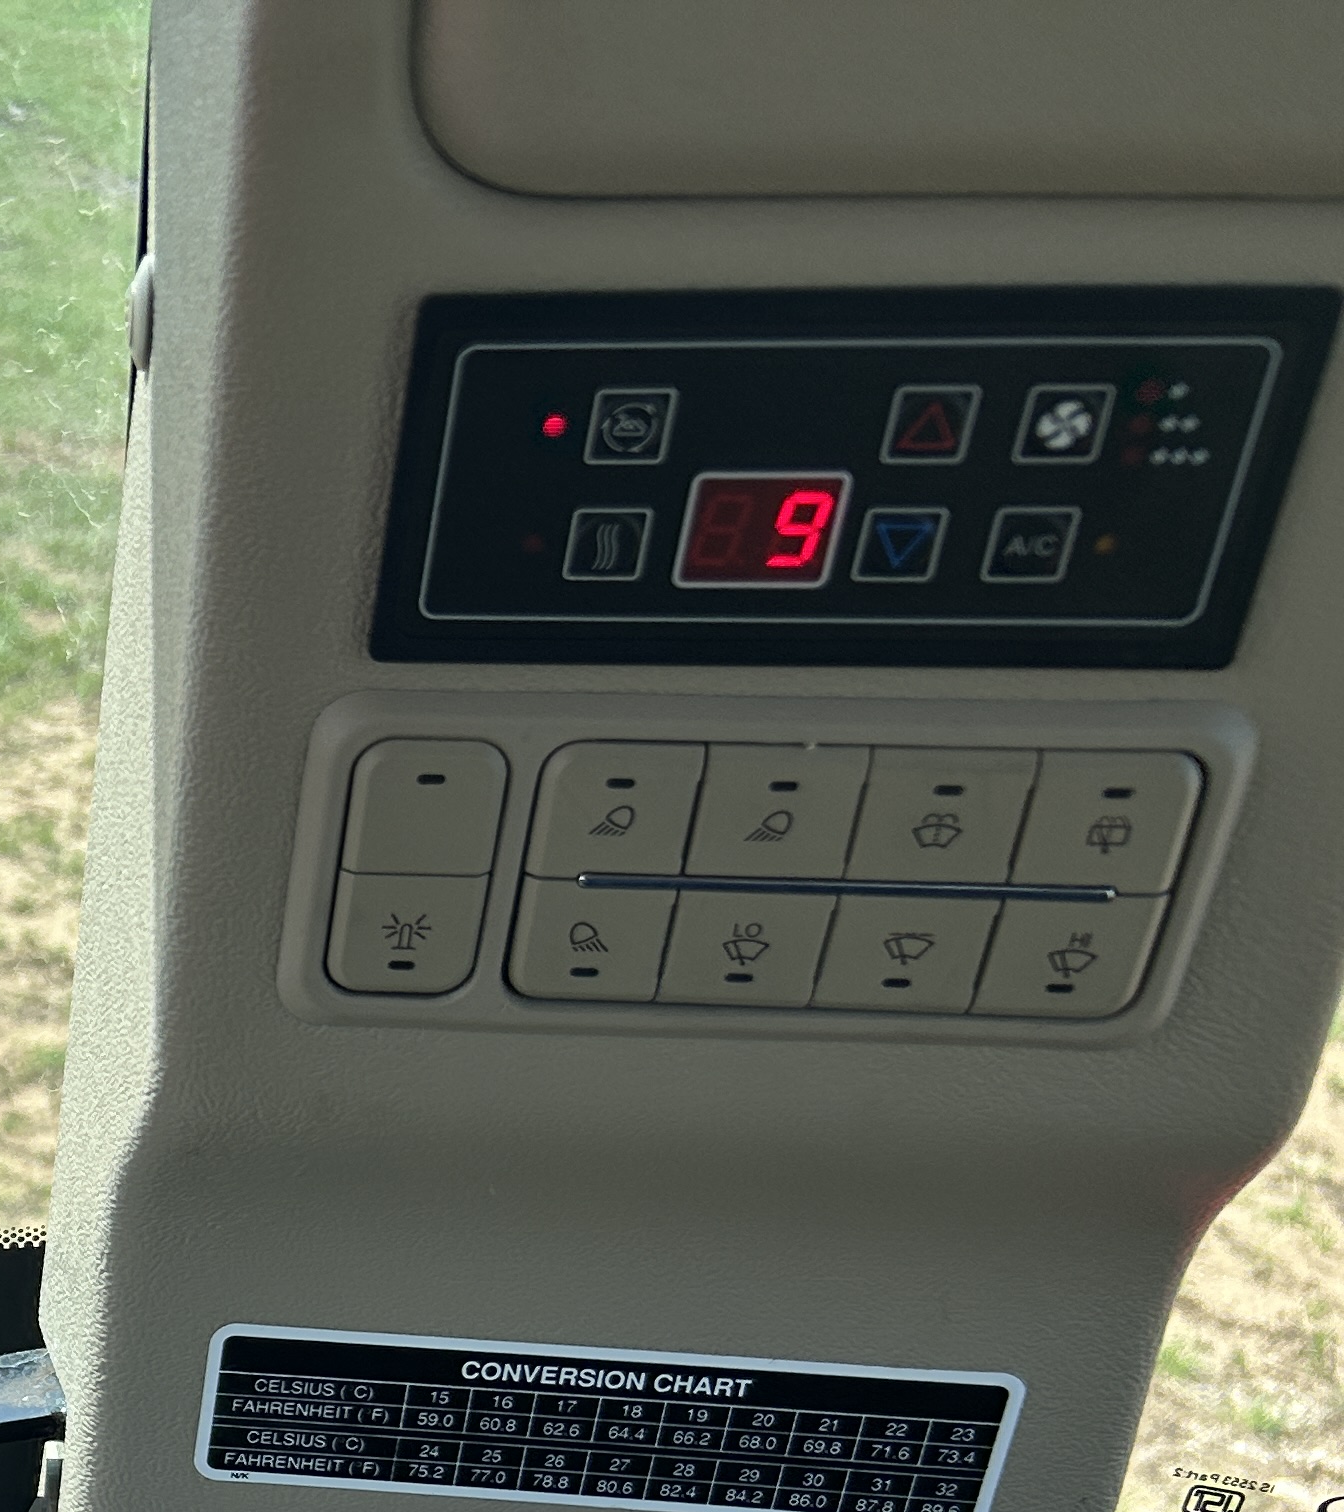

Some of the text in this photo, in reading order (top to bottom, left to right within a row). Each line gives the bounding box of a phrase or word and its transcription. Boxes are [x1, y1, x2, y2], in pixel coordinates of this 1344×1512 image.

[765, 488, 835, 568] 9
[1002, 534, 1060, 559] A/C
[732, 922, 763, 939] LO
[461, 1360, 753, 1398] CONVERSION CHART
[231, 1399, 353, 1420] FAHRENHEIT
[417, 1412, 454, 1428] 59.0
[479, 1417, 517, 1432] 60.8
[542, 1421, 580, 1437] 62.6
[608, 1425, 646, 1440] 64.4
[672, 1430, 712, 1446] 66.2
[738, 1434, 777, 1450] 68.0
[803, 1439, 842, 1455] 69.8
[870, 1444, 911, 1460] 71.6
[937, 1448, 976, 1464] 73.4
[254, 1378, 336, 1397] CELSIUS
[430, 1391, 450, 1405] 15
[493, 1396, 513, 1410] 16
[557, 1400, 578, 1414] 17
[622, 1405, 643, 1419] 18
[687, 1409, 709, 1423] 19
[752, 1413, 775, 1427] 20
[818, 1418, 840, 1432] 21
[884, 1423, 908, 1437] 22
[950, 1427, 976, 1442] 23
[223, 1452, 345, 1472] FAHRENHEIT
[408, 1463, 445, 1479] 75.2
[469, 1469, 507, 1484] 77.0
[532, 1473, 570, 1489] 78.8
[596, 1479, 634, 1495] 80.6
[659, 1484, 697, 1499] 82.4
[725, 1489, 763, 1504] 84.2
[788, 1493, 828, 1508] 86.0
[246, 1430, 328, 1449] CELSIUS
[419, 1444, 440, 1458] 24
[481, 1449, 502, 1463] 25
[544, 1454, 565, 1468] 26
[609, 1458, 631, 1472] 27
[673, 1463, 696, 1477] 28
[738, 1468, 760, 1483] 29
[802, 1472, 826, 1487] 30
[870, 1478, 894, 1492] 31
[935, 1483, 959, 1497] 32
